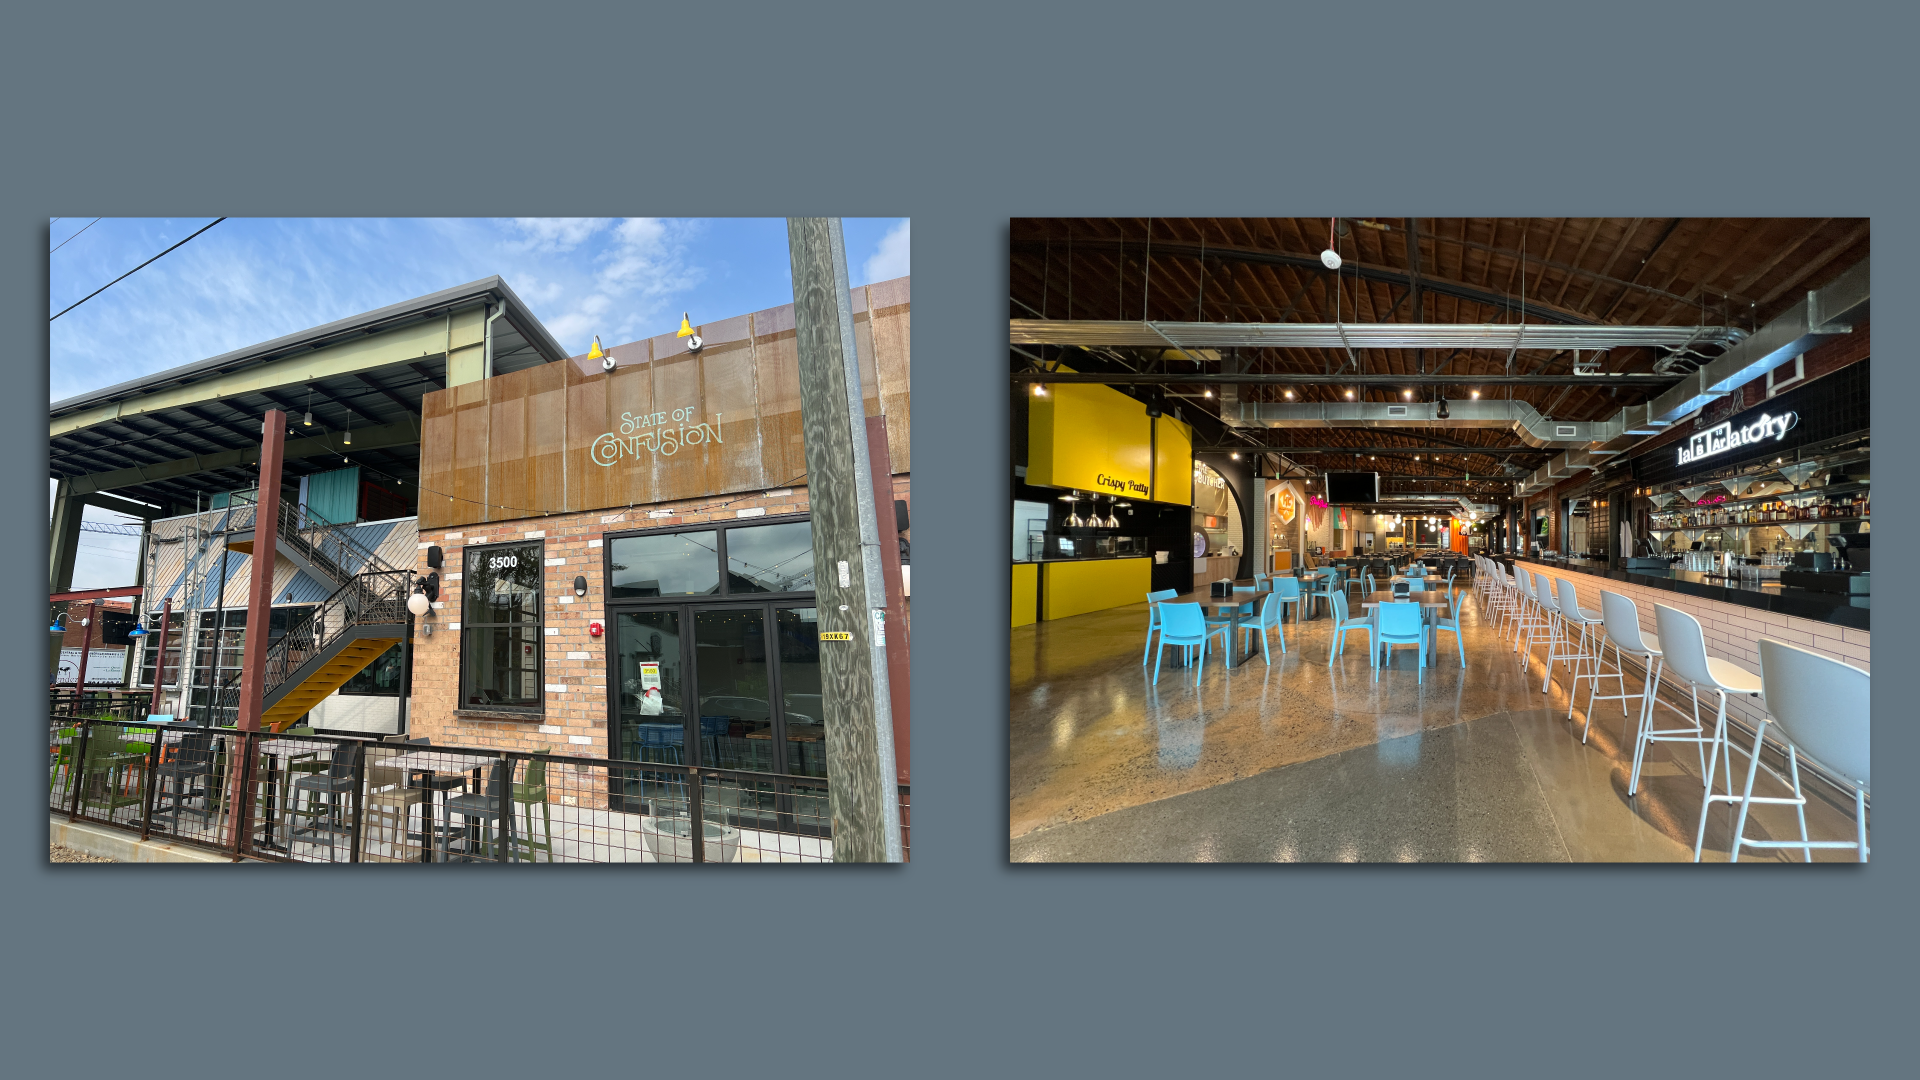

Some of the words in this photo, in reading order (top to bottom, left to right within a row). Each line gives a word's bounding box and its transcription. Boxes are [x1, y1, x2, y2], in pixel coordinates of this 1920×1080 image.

[620, 411, 668, 435] STATE
[672, 406, 695, 422] OF
[1096, 473, 1126, 492] Crispy
[1127, 479, 1149, 496] Patty
[1197, 473, 1226, 490] BUTCHER
[488, 555, 518, 569] 3500
